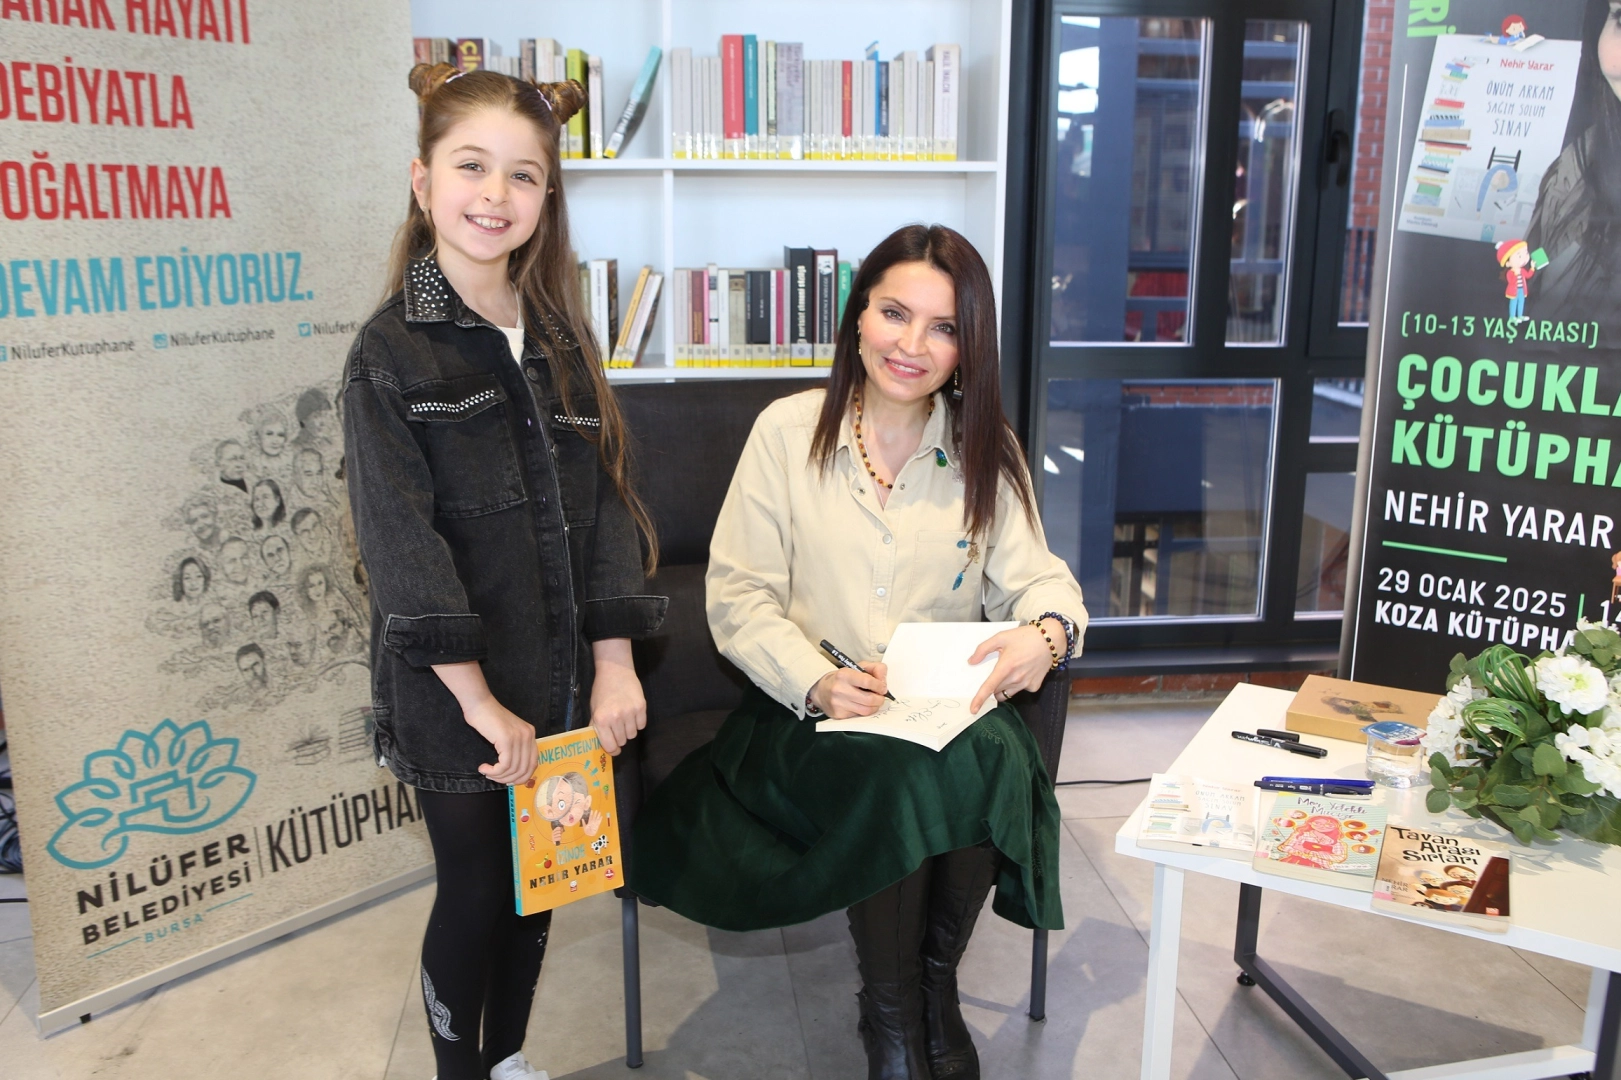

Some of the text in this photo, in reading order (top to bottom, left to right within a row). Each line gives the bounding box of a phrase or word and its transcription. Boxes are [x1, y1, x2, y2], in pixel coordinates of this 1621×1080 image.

[1500, 58, 1525, 70] Nehir
[1518, 84, 1555, 101] ARKAM
[1518, 103, 1546, 118] SOLUM
[1492, 117, 1532, 138] SINAV
[0, 150, 232, 221] OĞALTMAYA
[135, 246, 315, 311] EDİYORUZ.
[11, 338, 136, 361] NiluferKutuphane
[169, 327, 275, 350] NiluferKutuphane
[1401, 310, 1599, 349] (10-13 YAŞ ARASI)
[1384, 489, 1614, 550] NEHİR YARAR
[1377, 567, 1411, 594] 29
[1418, 572, 1487, 606] OCAK
[1494, 584, 1568, 618] 2025
[1374, 599, 1439, 634] KOZA
[1390, 826, 1459, 847] Tavan
[1420, 841, 1481, 856] Arası
[77, 832, 251, 915] NİLÜFER
[574, 855, 613, 876] YARAR
[1402, 849, 1479, 866] Sırları
[82, 861, 252, 945] BELEDİYESİ
[144, 912, 204, 943] BURSA
